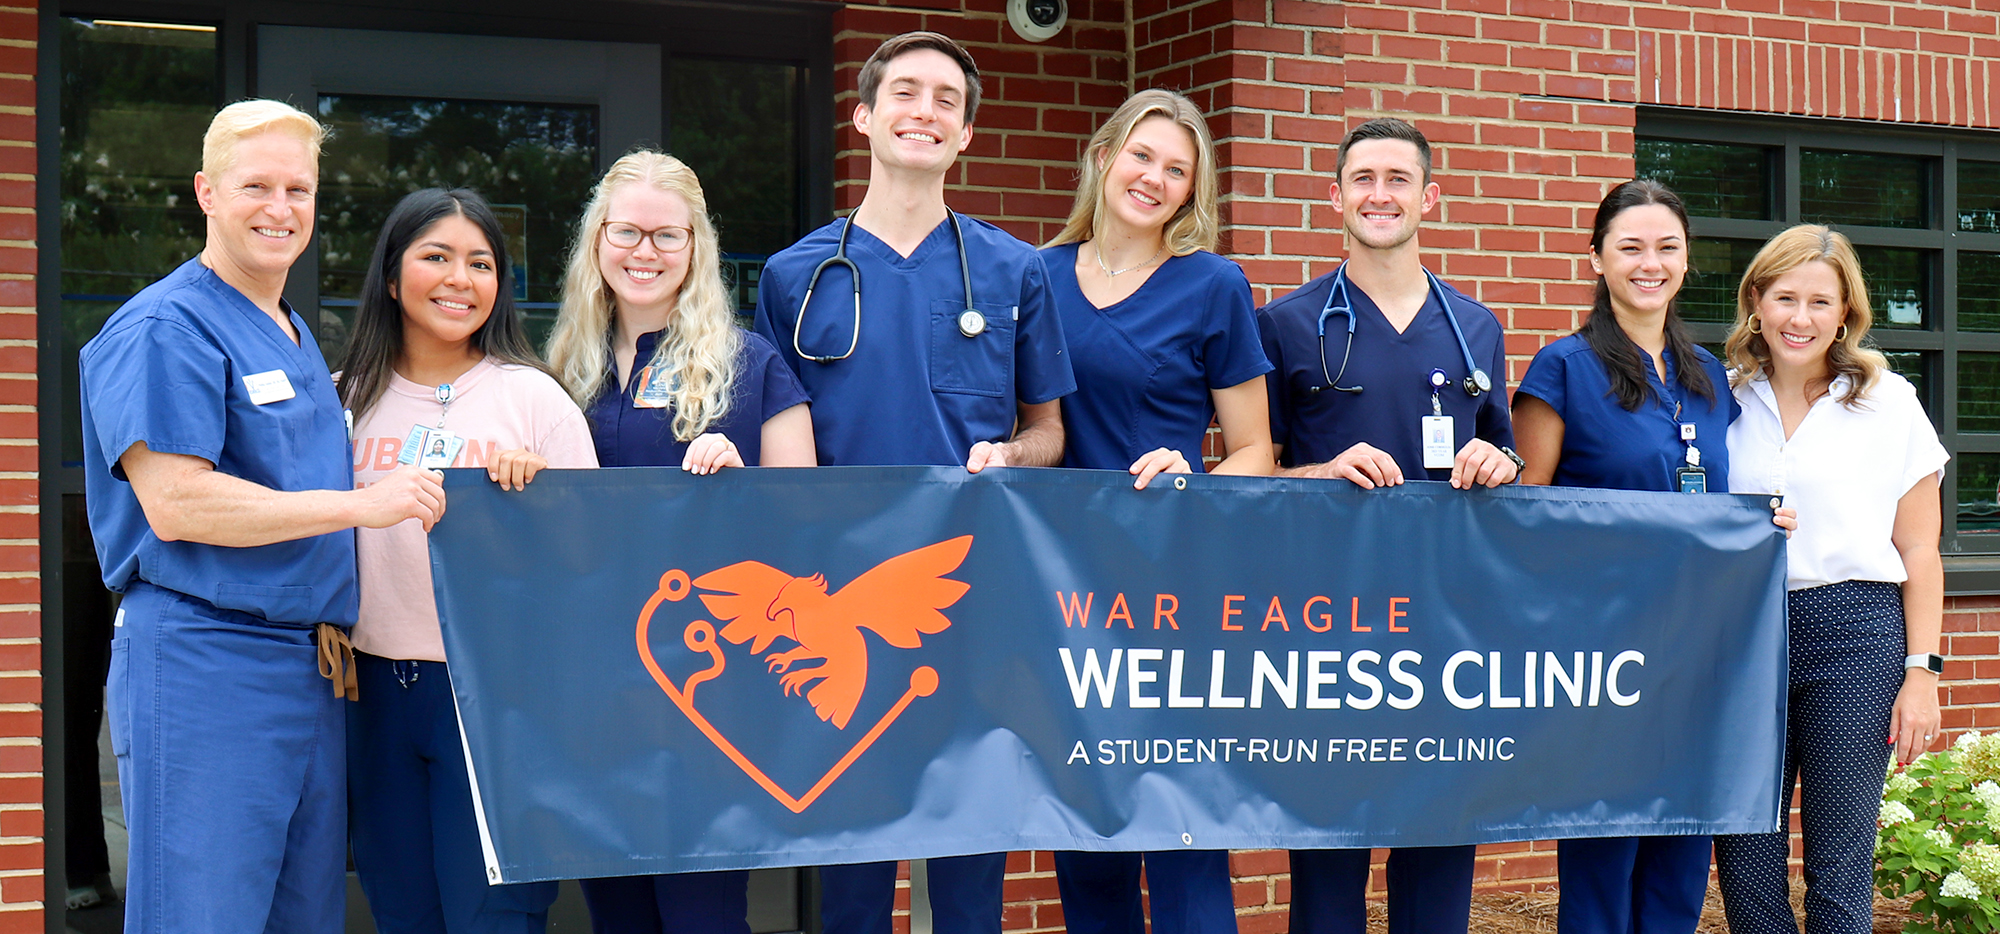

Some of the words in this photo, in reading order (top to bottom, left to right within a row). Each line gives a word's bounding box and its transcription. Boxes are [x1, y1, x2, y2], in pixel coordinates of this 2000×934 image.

[1056, 591, 1180, 631] WAR
[1221, 594, 1411, 633] EAGLE
[1058, 647, 1425, 710] WELLNESS
[1440, 650, 1646, 710] CLINIC
[1066, 740, 1091, 765] A
[1097, 738, 1318, 765] STUDENT-RUN
[1326, 738, 1409, 763] FREE
[1414, 736, 1516, 763] CLINIC
